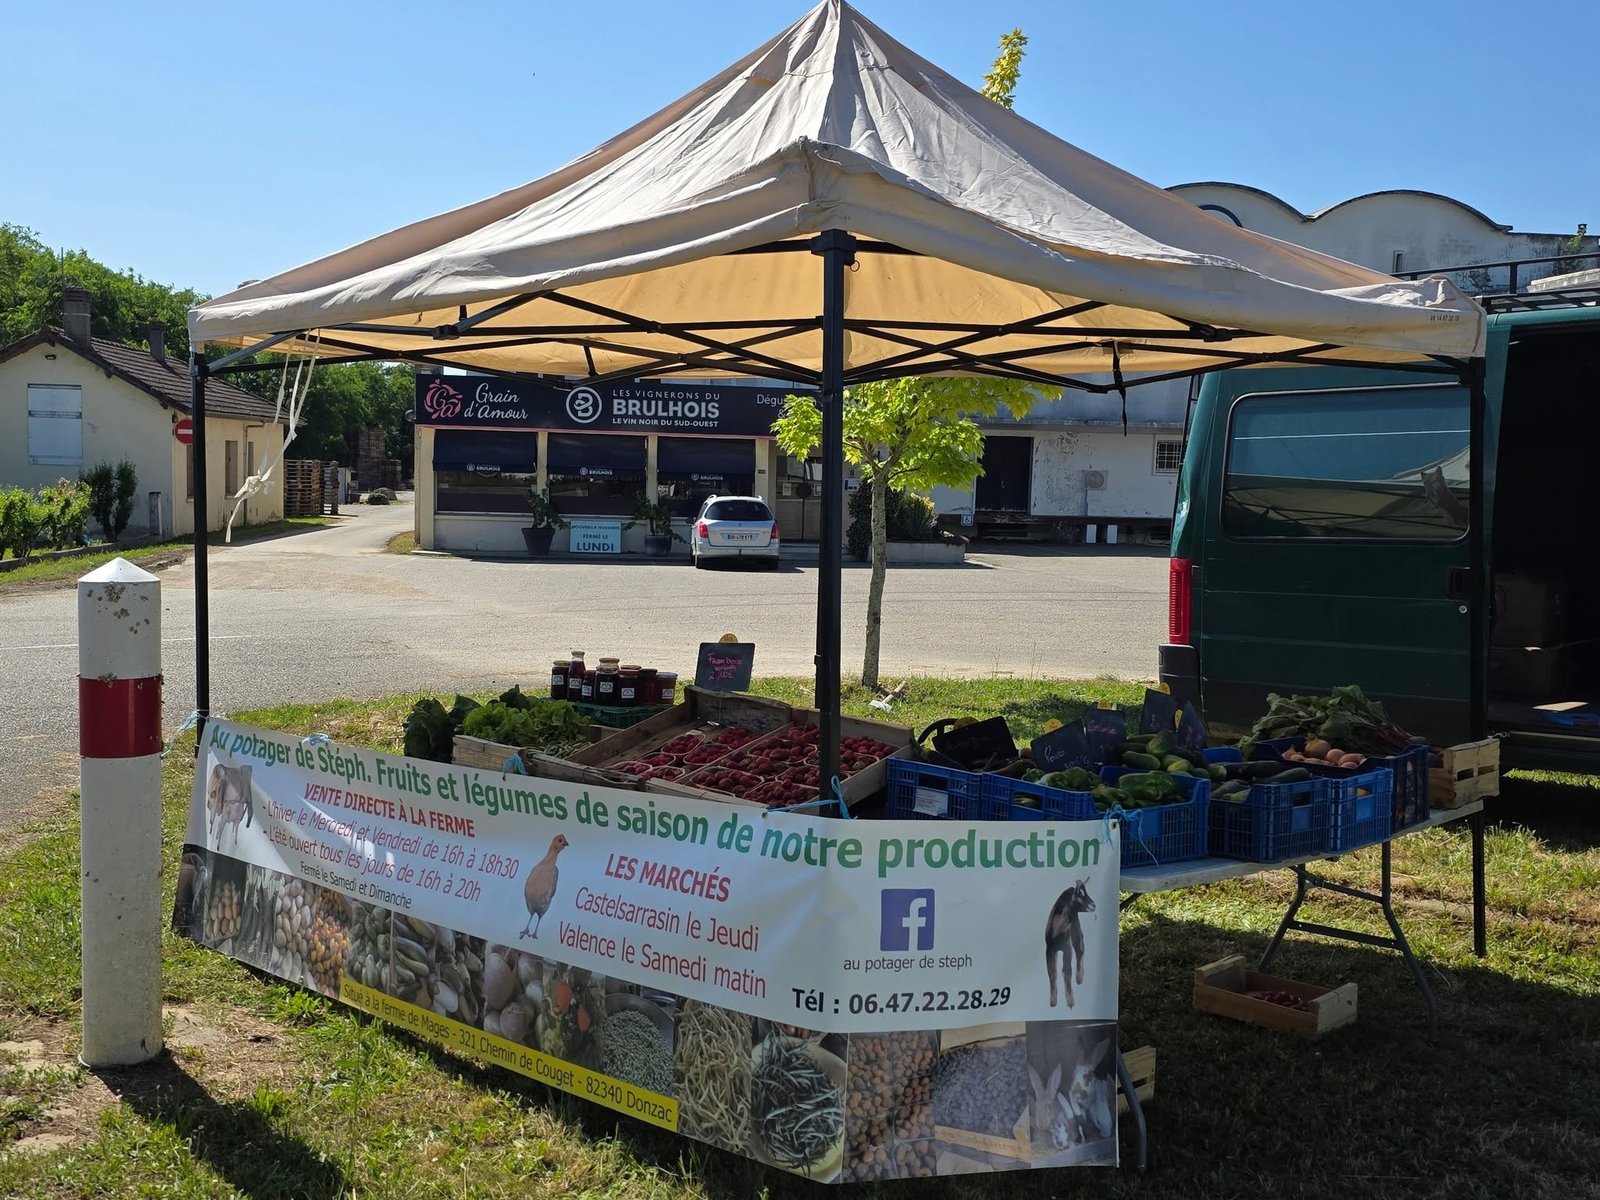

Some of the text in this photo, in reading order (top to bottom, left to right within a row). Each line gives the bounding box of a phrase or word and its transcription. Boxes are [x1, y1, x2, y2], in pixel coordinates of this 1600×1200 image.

[463, 401, 529, 419] d'Amour
[475, 382, 519, 403] Grain
[612, 399, 720, 419] BRULHOIS
[613, 389, 720, 400] LES VIGNERONS DU
[639, 418, 659, 426] NOIR
[674, 419, 719, 427] SUD-OUEST
[577, 542, 614, 551] LUNDI
[210, 725, 1100, 878] Au potager de Stéph. Fruits et légumes de saison de notre production
[304, 782, 475, 838] VENTE DIRECTE À LA FERME
[268, 800, 296, 822] L'hiver
[296, 808, 307, 826] le
[309, 811, 357, 839] Mercredi
[356, 825, 370, 841] et
[372, 826, 422, 855] Vendredi
[423, 839, 439, 859] de
[440, 843, 464, 866] 16h
[466, 847, 476, 869] à
[478, 852, 519, 879] 18h30
[269, 825, 287, 846] L'été
[289, 835, 317, 857] ouvert
[320, 842, 343, 864] tous
[344, 848, 360, 869] les
[361, 854, 395, 878] jours
[397, 863, 413, 883] de
[416, 868, 440, 891] 16h
[443, 873, 453, 895] à
[455, 878, 481, 902] 20h
[300, 860, 411, 909] Fermé le Samedi et Dimanche
[605, 853, 731, 902] LES MARCHÉS
[575, 886, 759, 952] Castelsarrasin le Jeudi
[559, 920, 766, 998] Valence le Samedi matin
[843, 953, 973, 973] au potager de steph
[791, 988, 824, 1013] Tél
[849, 986, 1011, 1015] 06.47.22.28.29
[344, 984, 363, 1003] Situé
[365, 995, 371, 1008] à
[372, 995, 380, 1011] la
[381, 998, 406, 1021] ferme
[408, 1012, 419, 1027] de
[421, 1014, 450, 1038] Mages
[459, 1028, 476, 1050] 321
[479, 1036, 517, 1066] Chemin
[519, 1050, 533, 1071] de
[536, 1057, 574, 1087] Couget
[586, 1076, 623, 1103] 82340
[626, 1092, 673, 1123] Donzac
